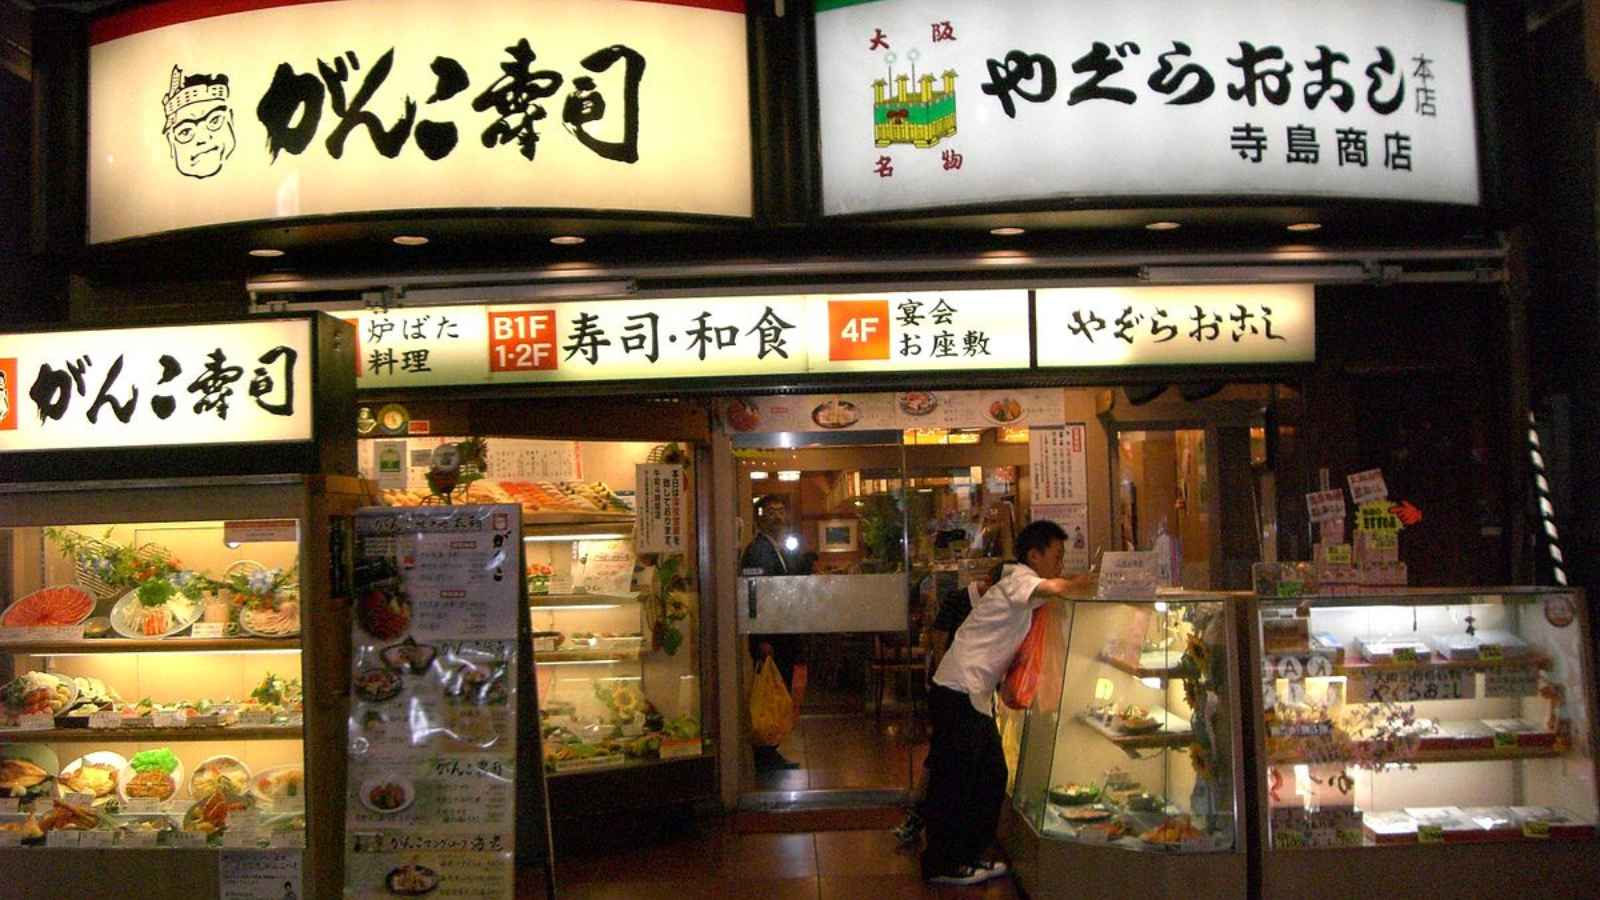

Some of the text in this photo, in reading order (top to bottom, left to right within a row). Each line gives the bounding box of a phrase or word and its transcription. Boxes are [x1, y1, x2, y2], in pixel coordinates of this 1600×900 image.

[869, 21, 957, 52] 大阪
[1411, 53, 1437, 117] 本店
[1231, 123, 1413, 171] 寺島商店
[874, 150, 964, 178] 名物
[494, 314, 548, 338] B1F
[896, 298, 958, 326] 宴会
[367, 313, 460, 343] 炉ばた
[841, 318, 879, 342] 4F
[900, 329, 991, 358] お座敷
[368, 347, 432, 375] 料理
